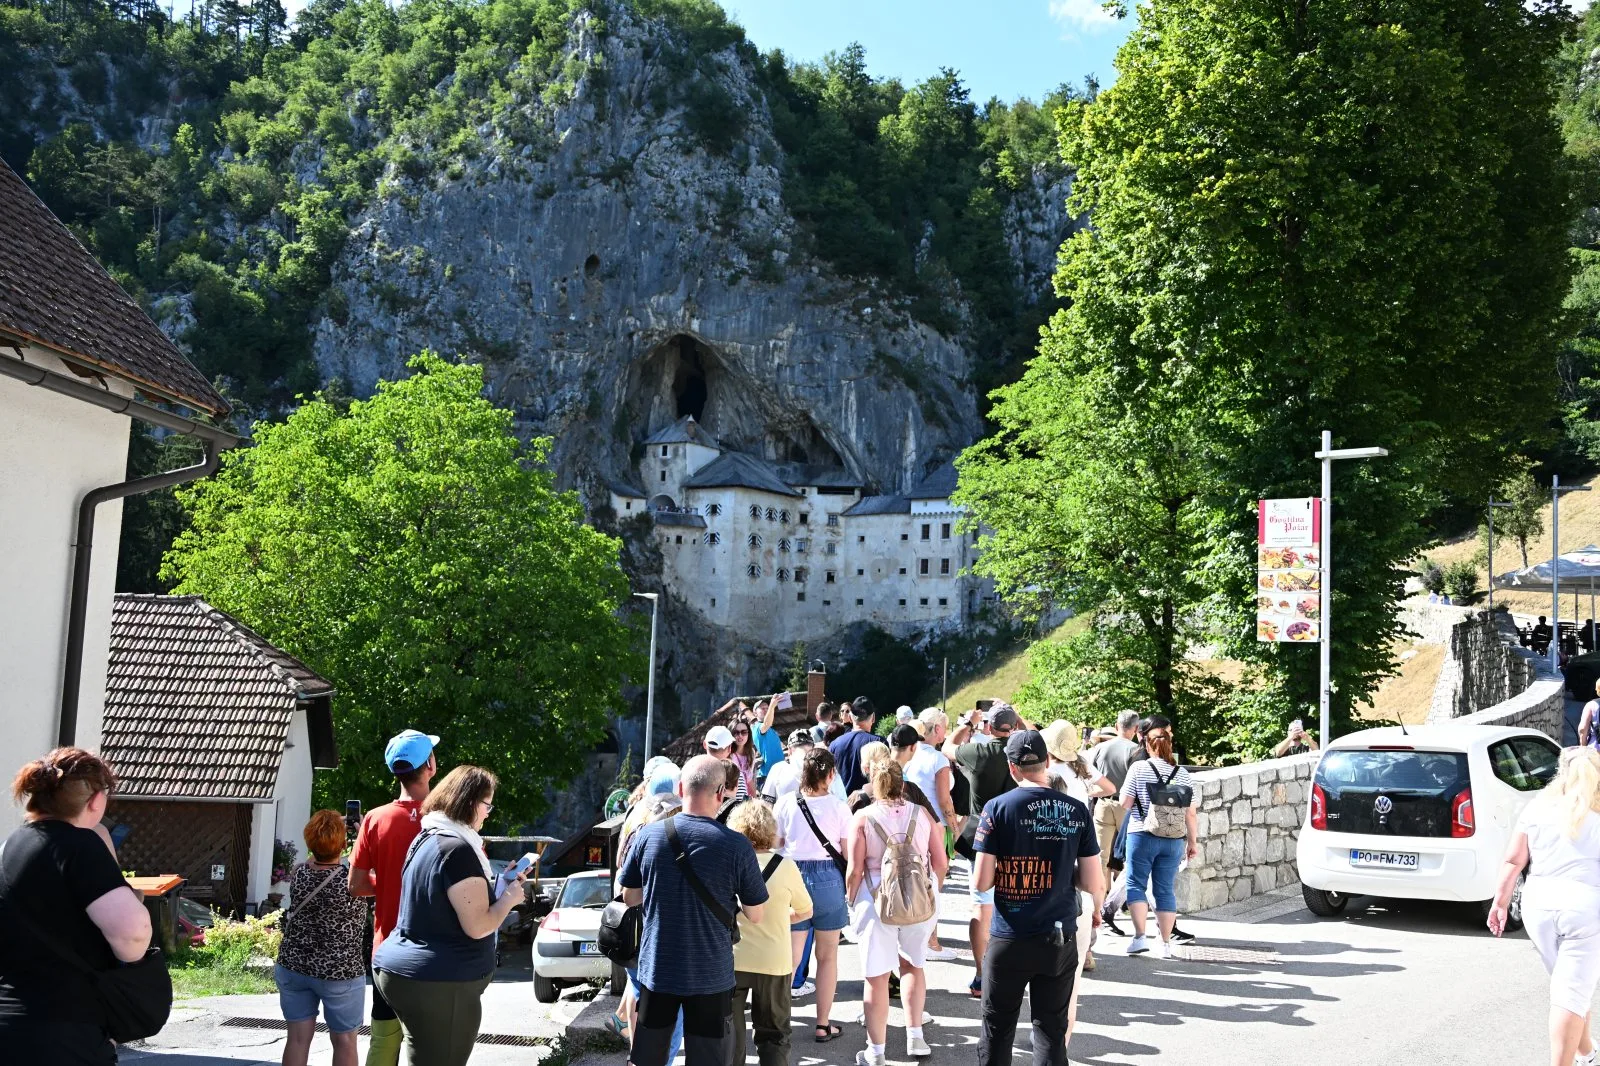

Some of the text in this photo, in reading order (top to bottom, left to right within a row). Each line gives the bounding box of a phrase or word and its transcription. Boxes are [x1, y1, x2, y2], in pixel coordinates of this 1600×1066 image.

[1027, 800, 1076, 813] OCEAN SPIRIT
[1358, 852, 1416, 866] PO FM-733
[1022, 874, 1052, 888] WEAR
[586, 943, 598, 952] PO
